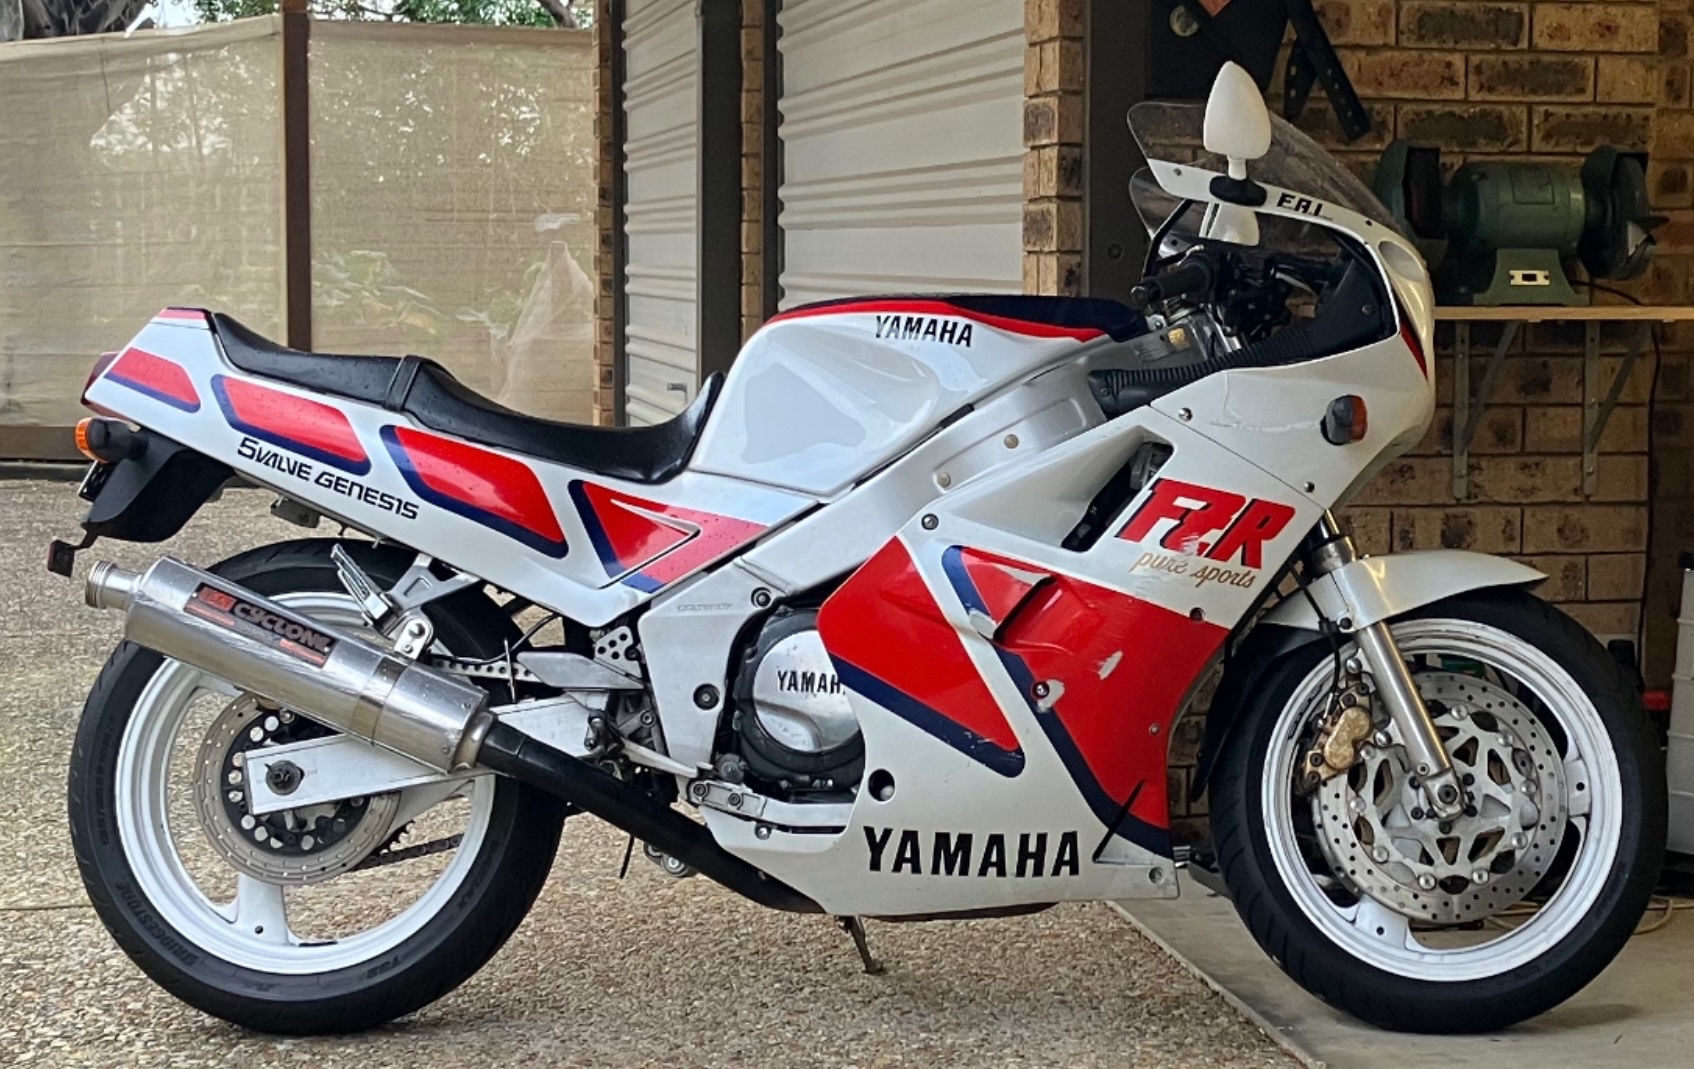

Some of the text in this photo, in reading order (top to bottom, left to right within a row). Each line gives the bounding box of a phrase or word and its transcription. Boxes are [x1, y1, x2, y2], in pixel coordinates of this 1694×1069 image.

[876, 315, 973, 348] YAMAHA
[314, 471, 420, 520] GENESIS
[1114, 478, 1296, 570] FZR
[1129, 552, 1256, 588] pure sports
[777, 670, 846, 696] YAMAH
[863, 826, 1080, 878] YAMAHA
